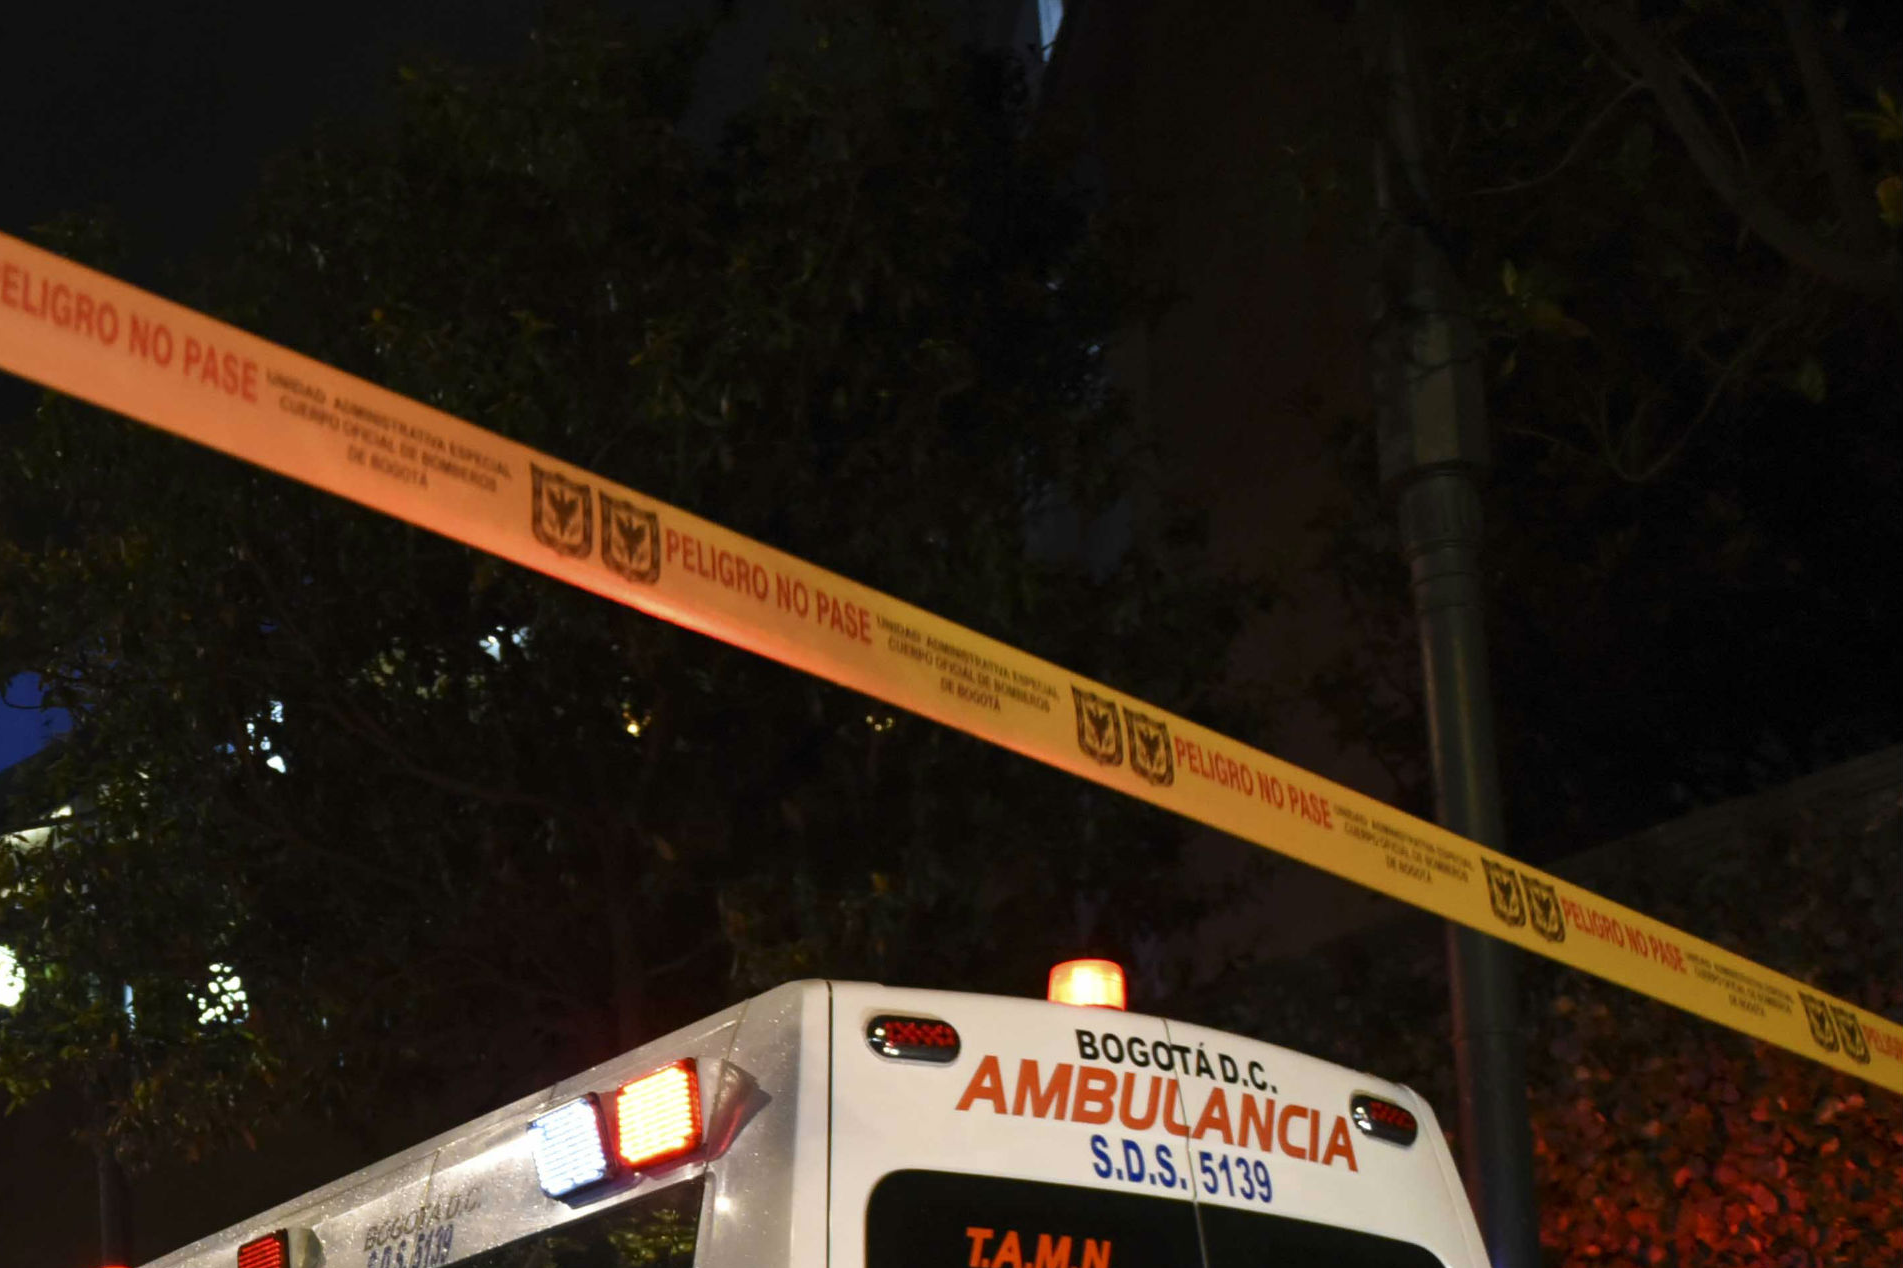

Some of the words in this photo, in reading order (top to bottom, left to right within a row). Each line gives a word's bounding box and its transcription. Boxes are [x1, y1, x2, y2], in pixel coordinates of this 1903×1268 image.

[129, 312, 174, 369] NO
[183, 334, 258, 404] PASE
[666, 527, 769, 601] PELIGRO
[776, 571, 809, 618] NO
[816, 588, 872, 645] PASE
[1174, 734, 1254, 797] PELIGRO
[1257, 769, 1284, 810] NO
[1287, 783, 1333, 831] PASE
[1560, 896, 1625, 949] PELIGRO
[1625, 923, 1648, 959] NO
[1648, 934, 1687, 975] PASE
[1075, 1029, 1215, 1080] BOGOTÁ
[1221, 1053, 1279, 1094] D.C.
[955, 1054, 1360, 1173] AMBULANCIA
[1090, 1133, 1188, 1190] S.D.S.
[1197, 1150, 1273, 1203] 5139
